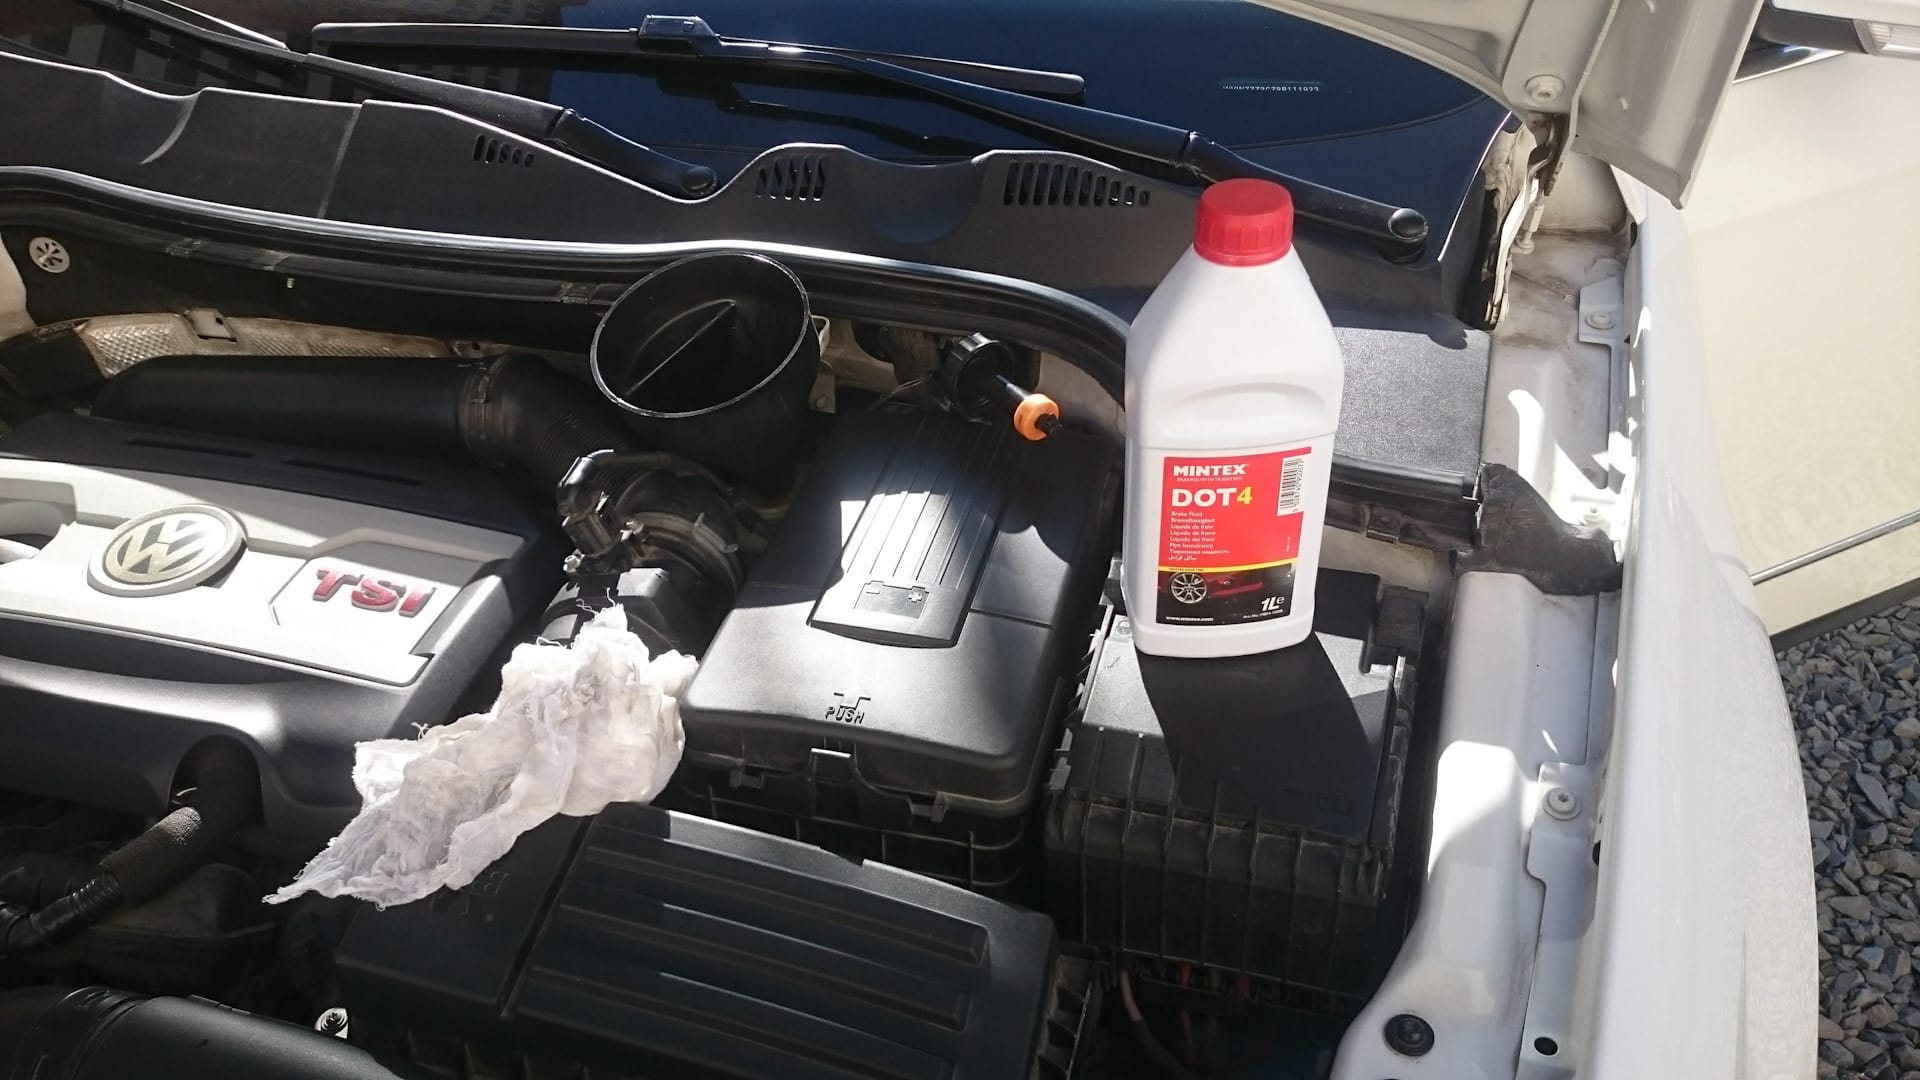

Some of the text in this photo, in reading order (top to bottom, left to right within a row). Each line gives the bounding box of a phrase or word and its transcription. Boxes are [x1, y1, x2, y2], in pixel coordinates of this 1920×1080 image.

[1173, 463, 1247, 477] MINTEX
[312, 567, 438, 618] TSI
[825, 706, 865, 724] PUSH
